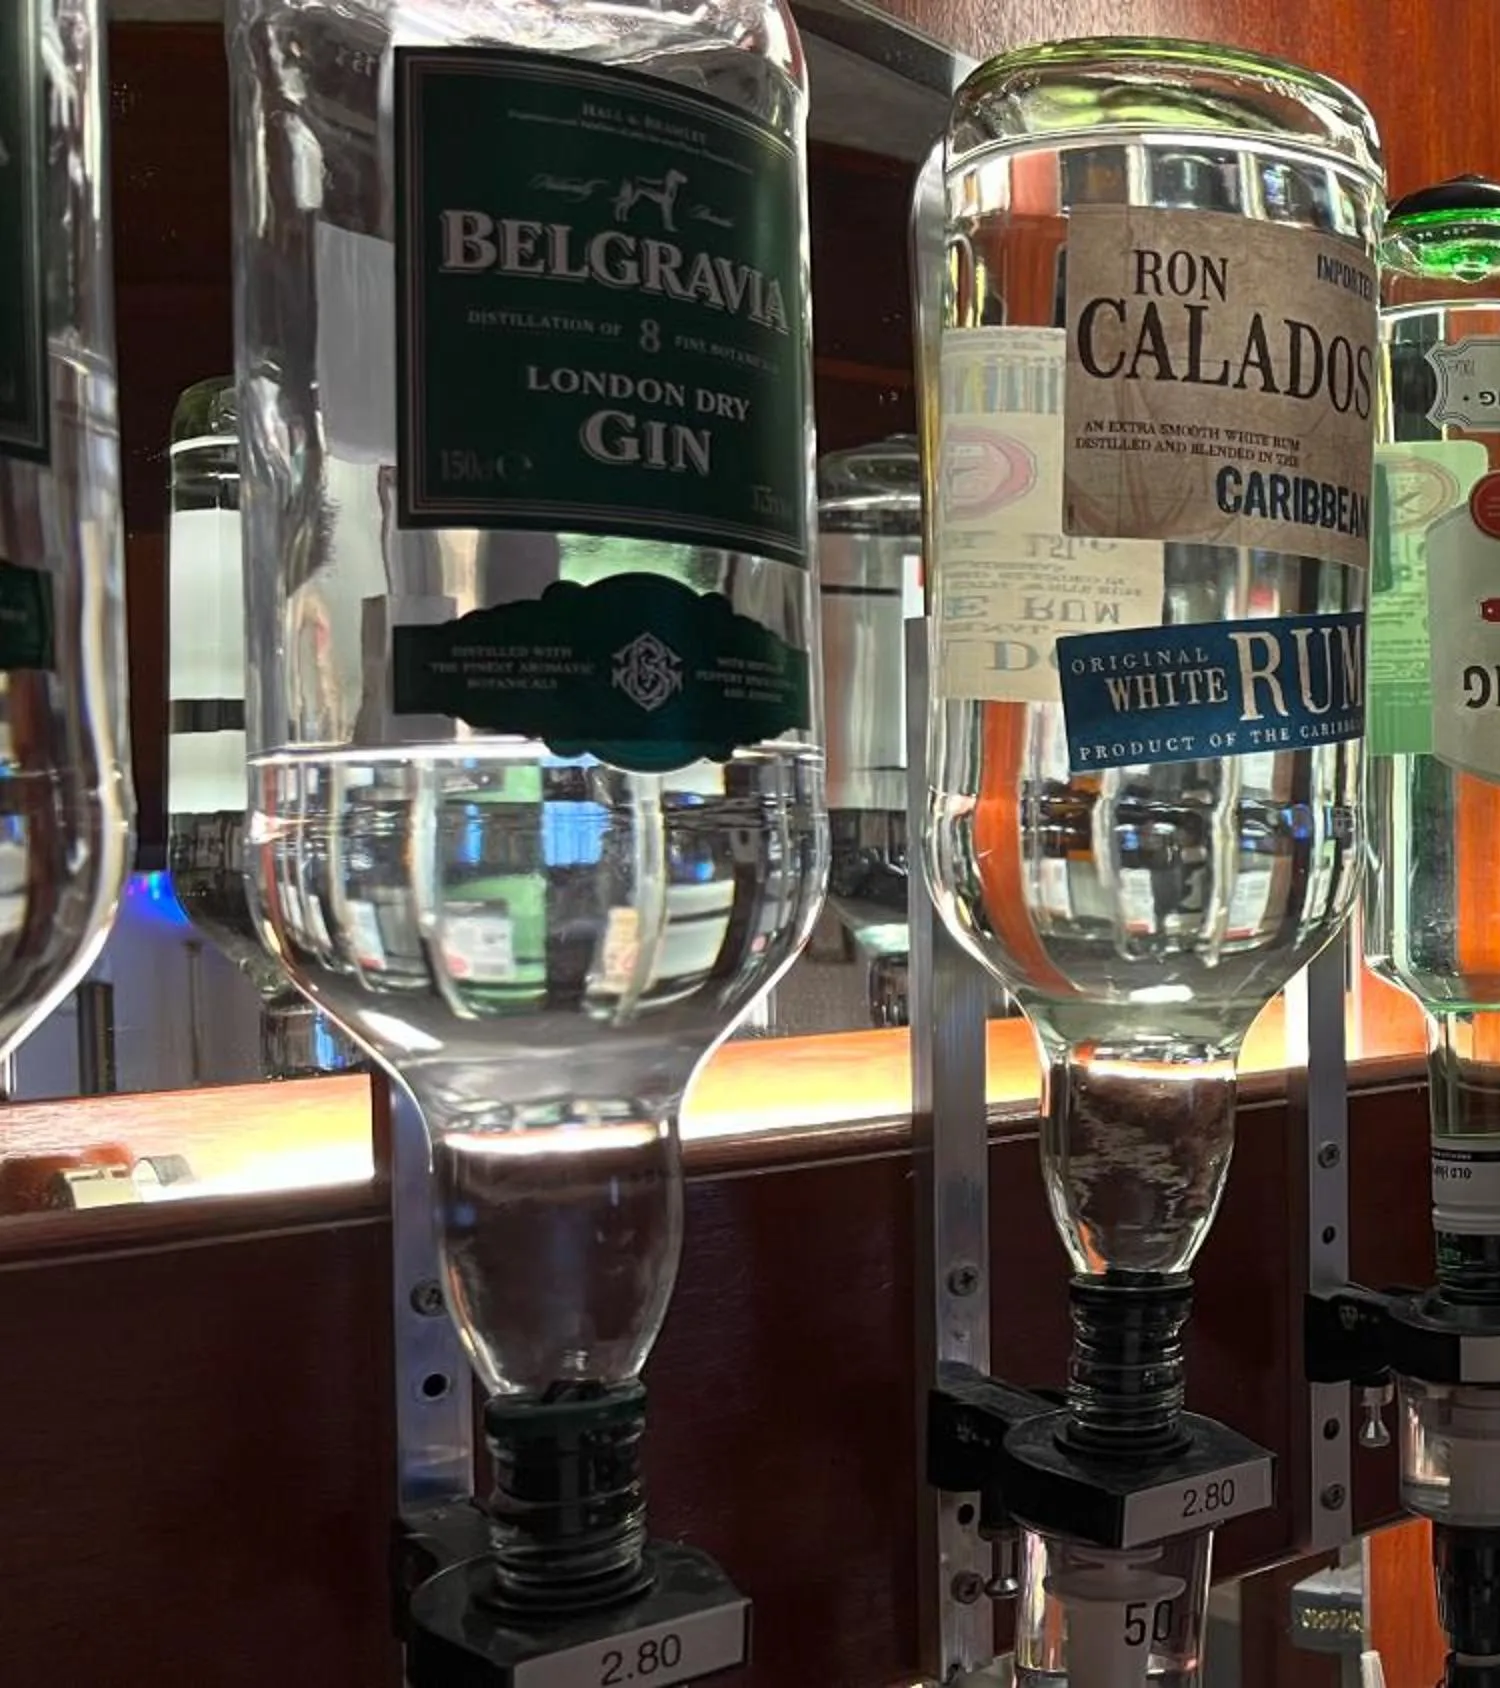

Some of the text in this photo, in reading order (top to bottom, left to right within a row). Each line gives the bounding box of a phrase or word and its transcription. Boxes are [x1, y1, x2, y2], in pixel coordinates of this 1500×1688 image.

[439, 208, 789, 335] BELGRAVIA
[1133, 249, 1229, 302] RON
[468, 308, 595, 335] DISTILLATION
[598, 322, 623, 337] OF
[639, 319, 662, 354] 8
[1077, 298, 1373, 420] CALADOS
[527, 366, 751, 422] LONDON DRY
[579, 410, 713, 476] GIN
[1075, 437, 1299, 468] DISTILLED AND BLENDED IN THE
[1084, 420, 1301, 452] AN EXTRA SMOOTH WHITE RUM
[1216, 465, 1369, 537] CARIBBEAN
[1071, 645, 1210, 675] ORIGINAL
[1105, 624, 1363, 721] WHITE RUM
[1079, 734, 1196, 762] PRODUCT
[1209, 731, 1238, 749] OF
[1251, 726, 1290, 745] THE
[1181, 1478, 1236, 1518] 2.80
[1123, 1599, 1174, 1647] 50
[601, 1633, 682, 1687] 2.80
